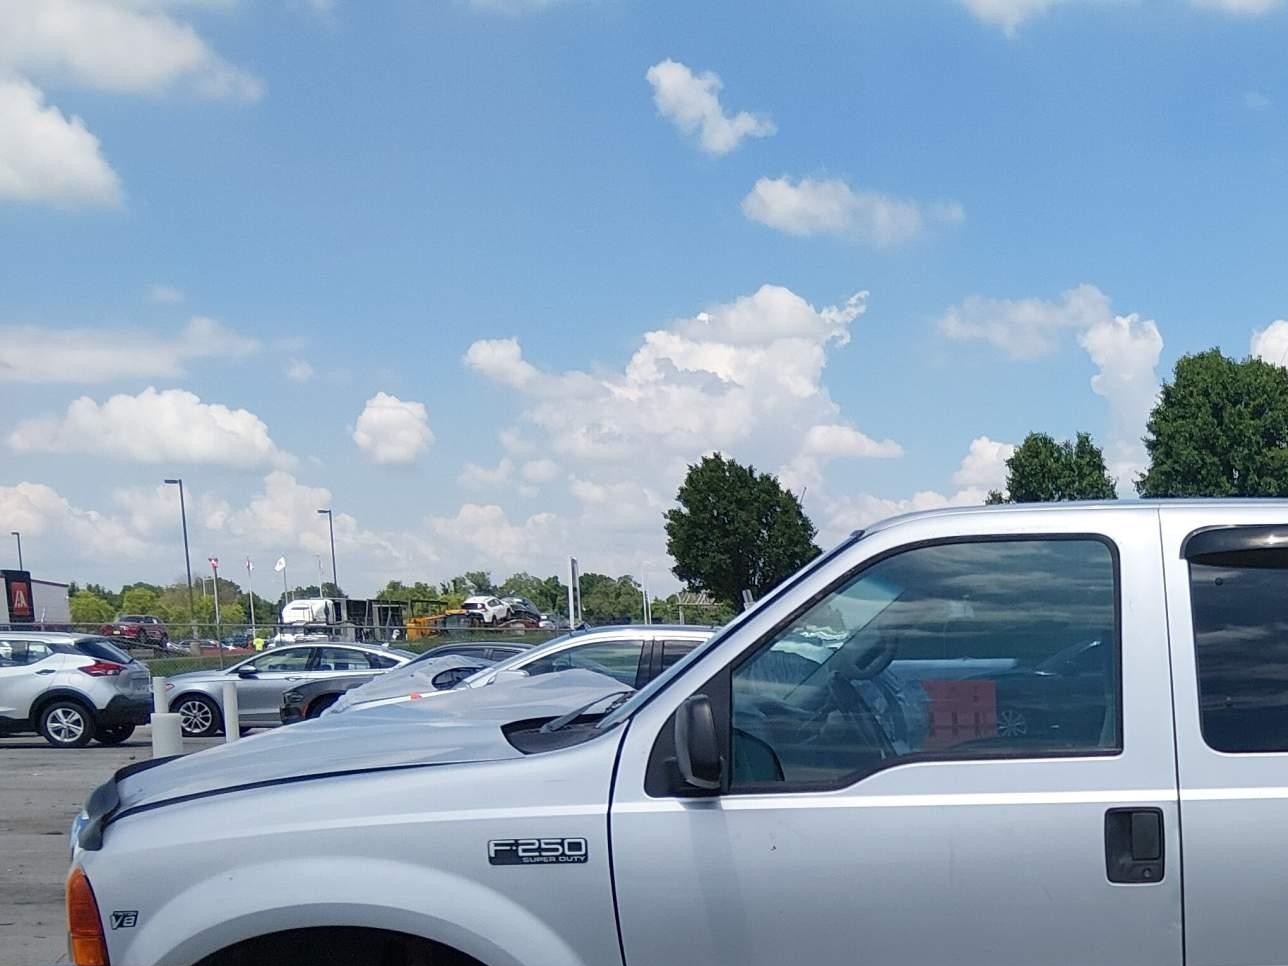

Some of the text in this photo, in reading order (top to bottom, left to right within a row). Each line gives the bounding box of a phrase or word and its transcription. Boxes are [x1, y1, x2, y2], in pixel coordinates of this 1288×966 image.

[522, 855, 587, 864] SUPER DUTY
[109, 914, 136, 930] V8
